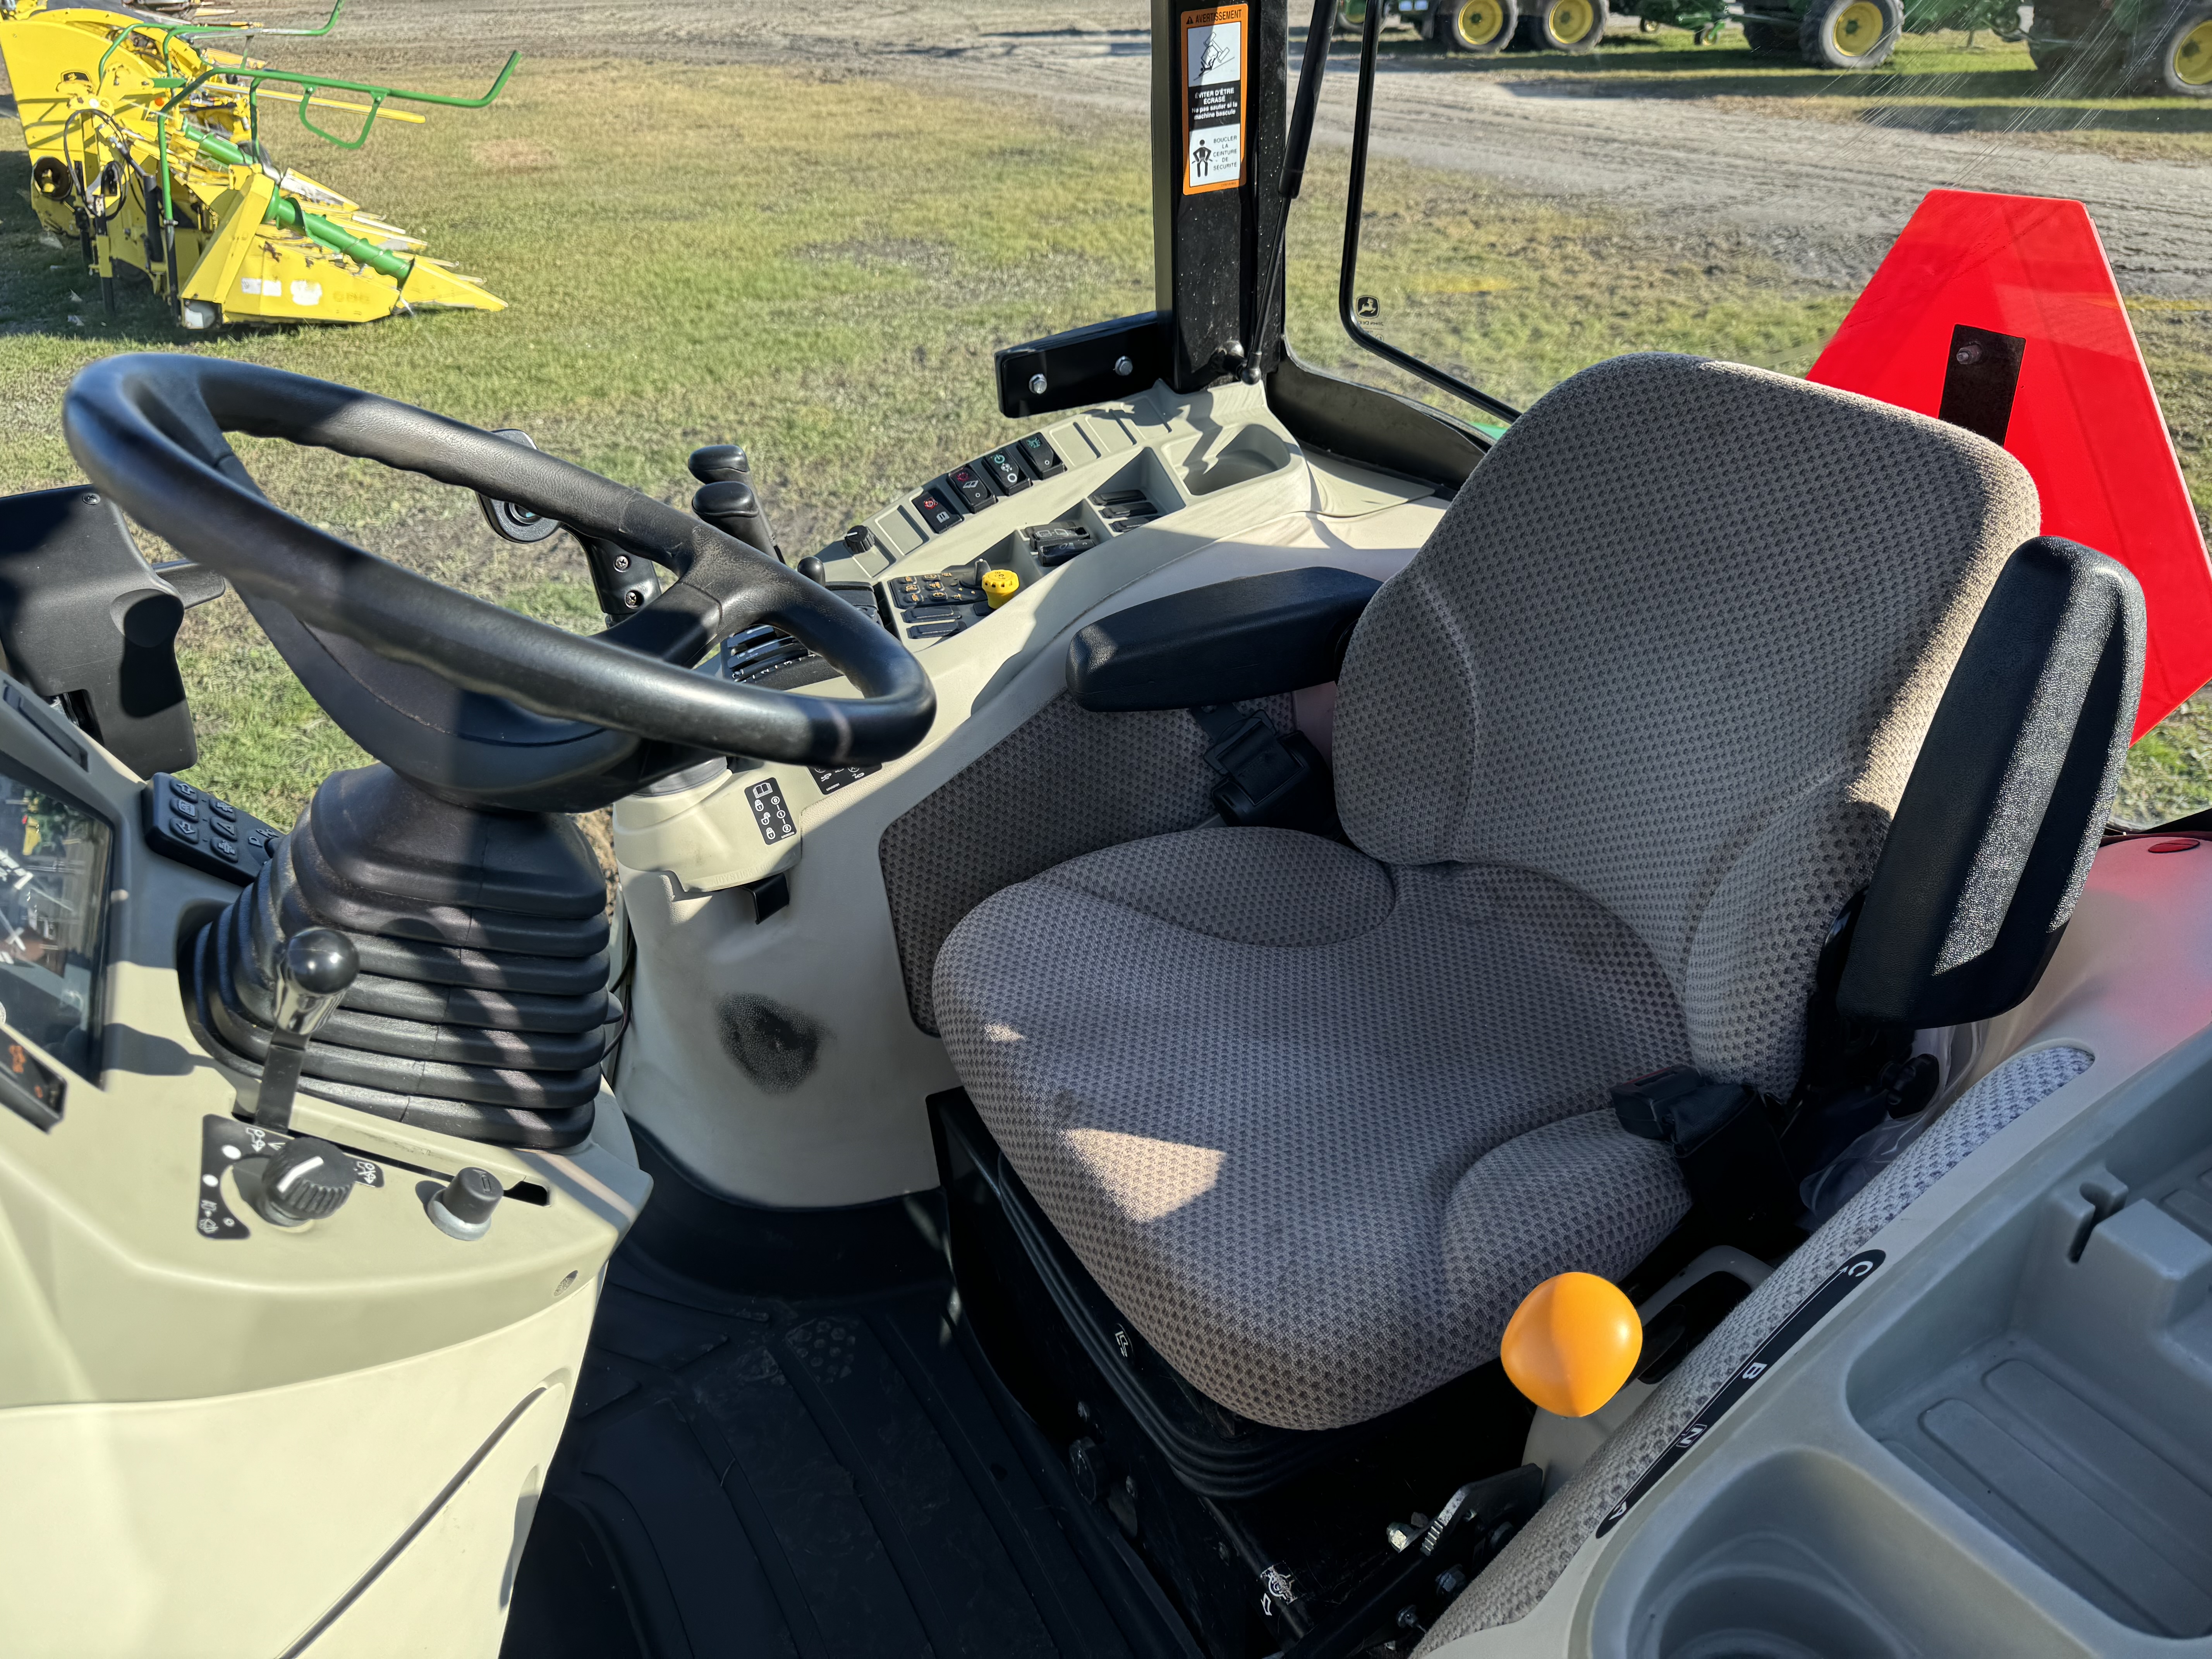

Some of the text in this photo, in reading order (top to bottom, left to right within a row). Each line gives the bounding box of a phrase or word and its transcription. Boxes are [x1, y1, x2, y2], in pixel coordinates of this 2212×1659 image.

[1195, 9, 1242, 24] AVERTISSEMENT
[1195, 87, 1234, 99] ÉVITER D'ÊTRE
[1204, 95, 1226, 105] ÉCRASÉ
[1216, 109, 1236, 117] bascule
[1213, 149, 1237, 157] CEINTURE
[713, 868, 753, 885] JOYSTICK
[1848, 1261, 1873, 1277] C
[1742, 1362, 1767, 1379] B
[1680, 1428, 1703, 1444] N
[1609, 1501, 1627, 1520] A
